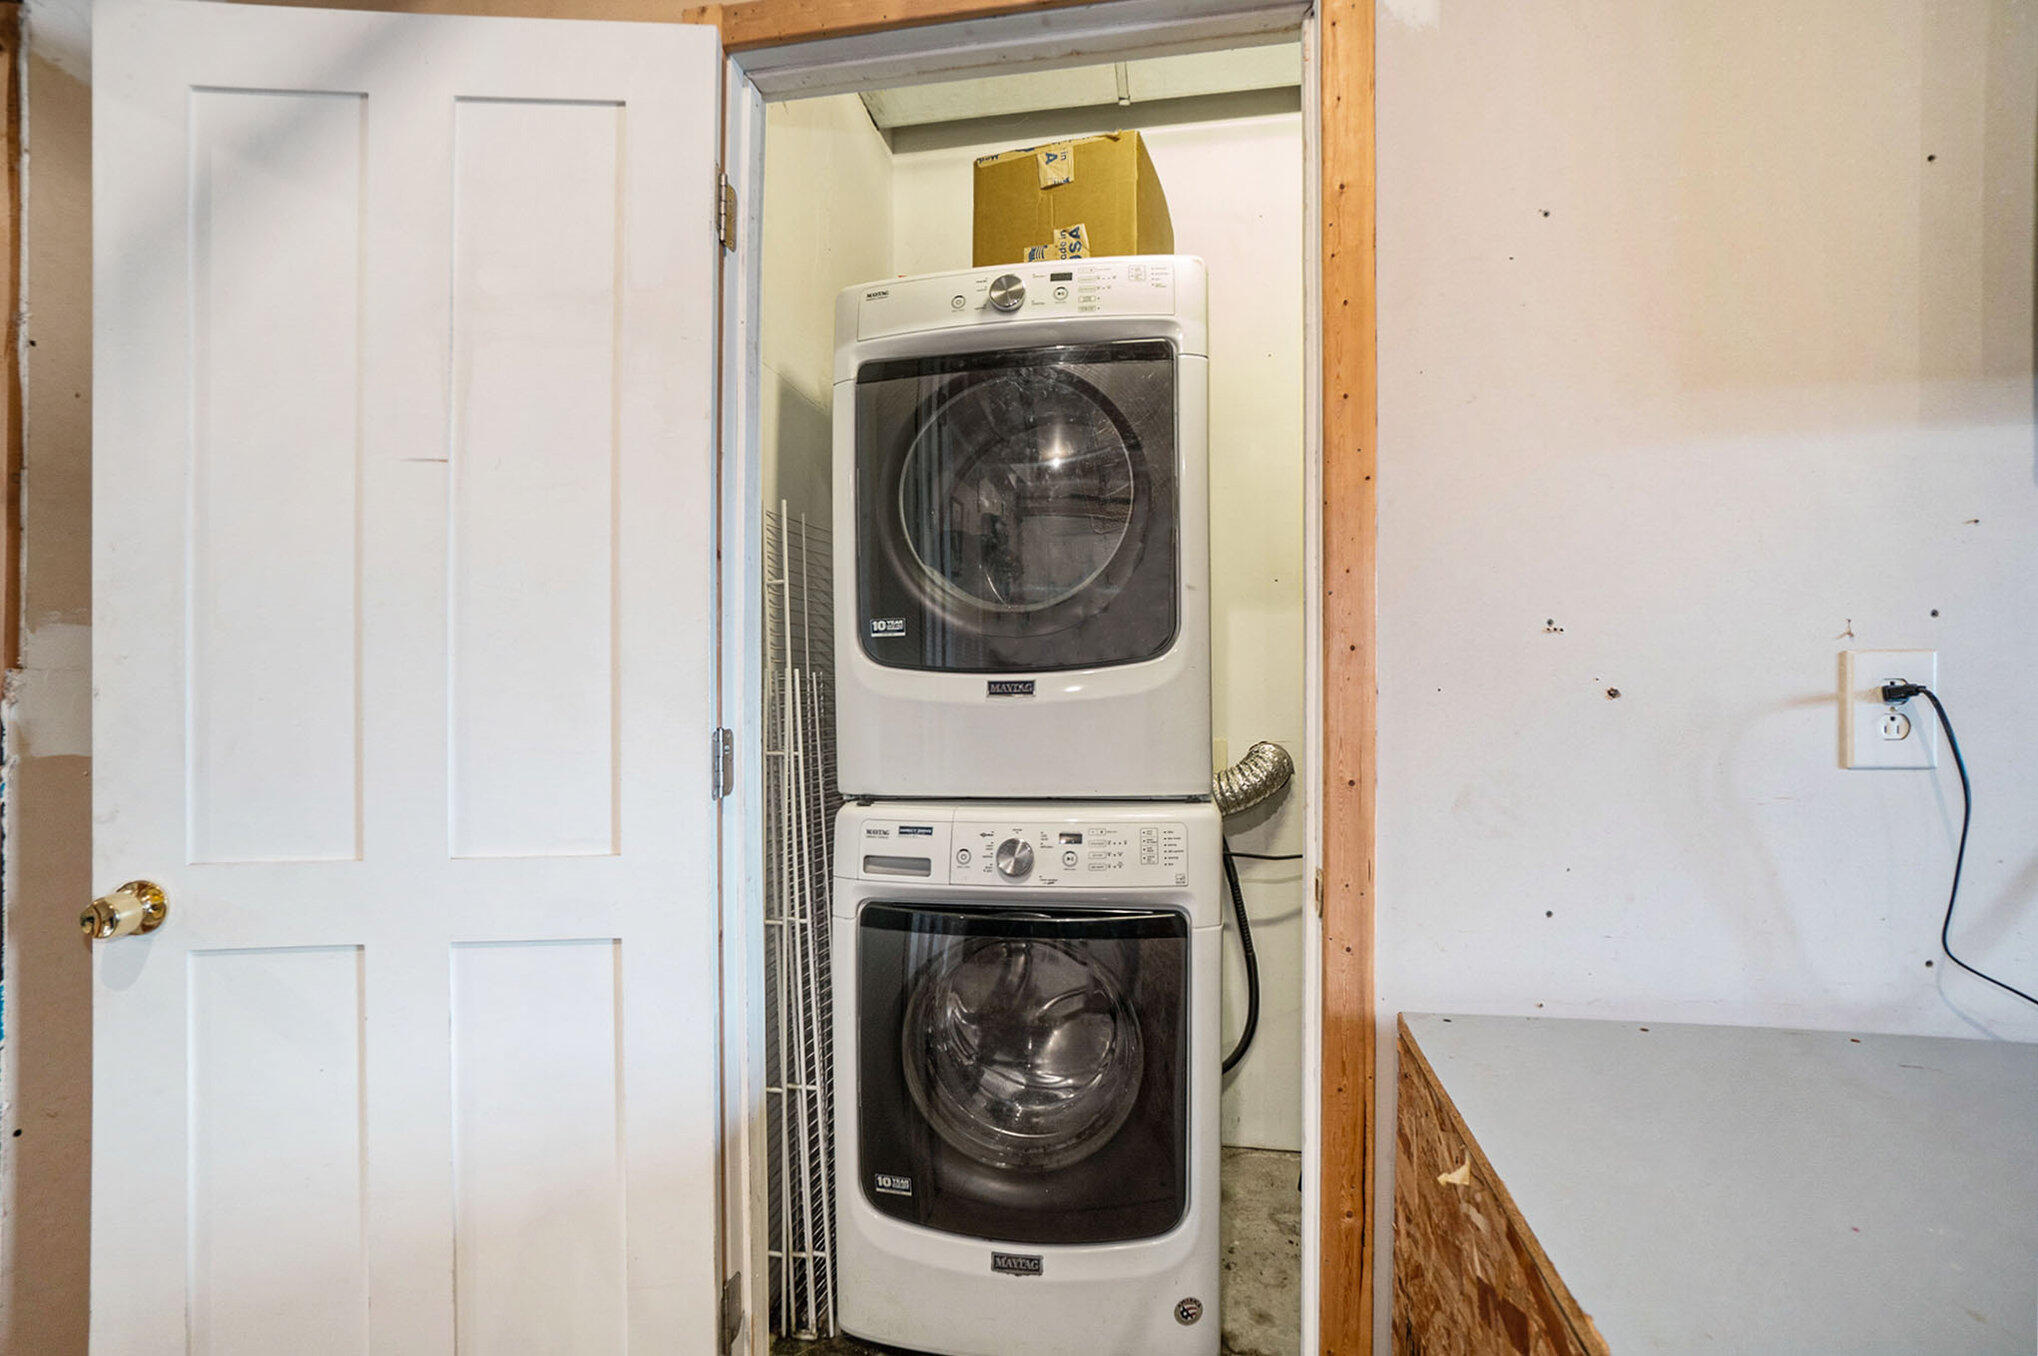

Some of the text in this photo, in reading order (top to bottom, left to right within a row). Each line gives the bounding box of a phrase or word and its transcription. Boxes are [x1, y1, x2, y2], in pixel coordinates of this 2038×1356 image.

[1069, 226, 1082, 259] SA
[872, 620, 886, 631] 10
[990, 683, 1033, 693] MAYTAG
[877, 1176, 892, 1187] 10
[995, 1256, 1039, 1270] MAYTAG
